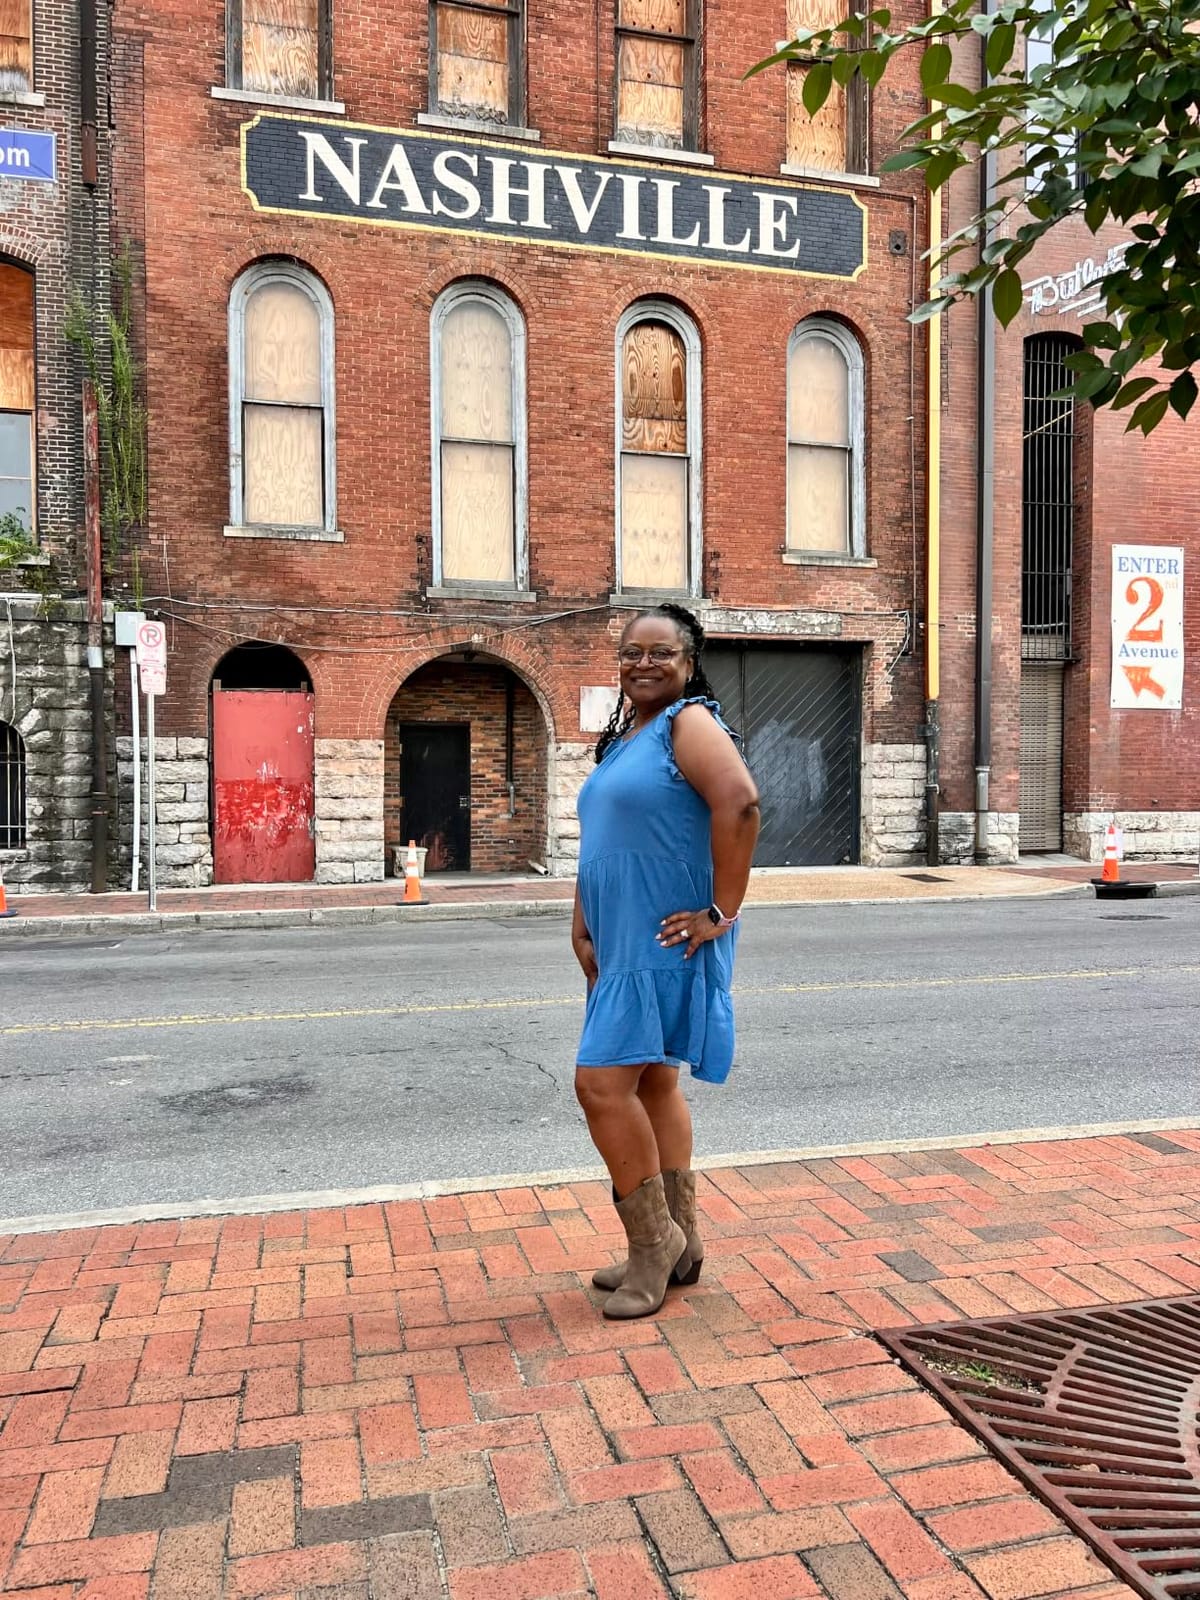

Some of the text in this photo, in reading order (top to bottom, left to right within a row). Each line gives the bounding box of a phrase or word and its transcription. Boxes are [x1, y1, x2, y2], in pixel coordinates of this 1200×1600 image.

[297, 130, 800, 259] NASHVILLE
[1118, 557, 1179, 574] ENTER
[1118, 643, 1179, 658] Avenue
